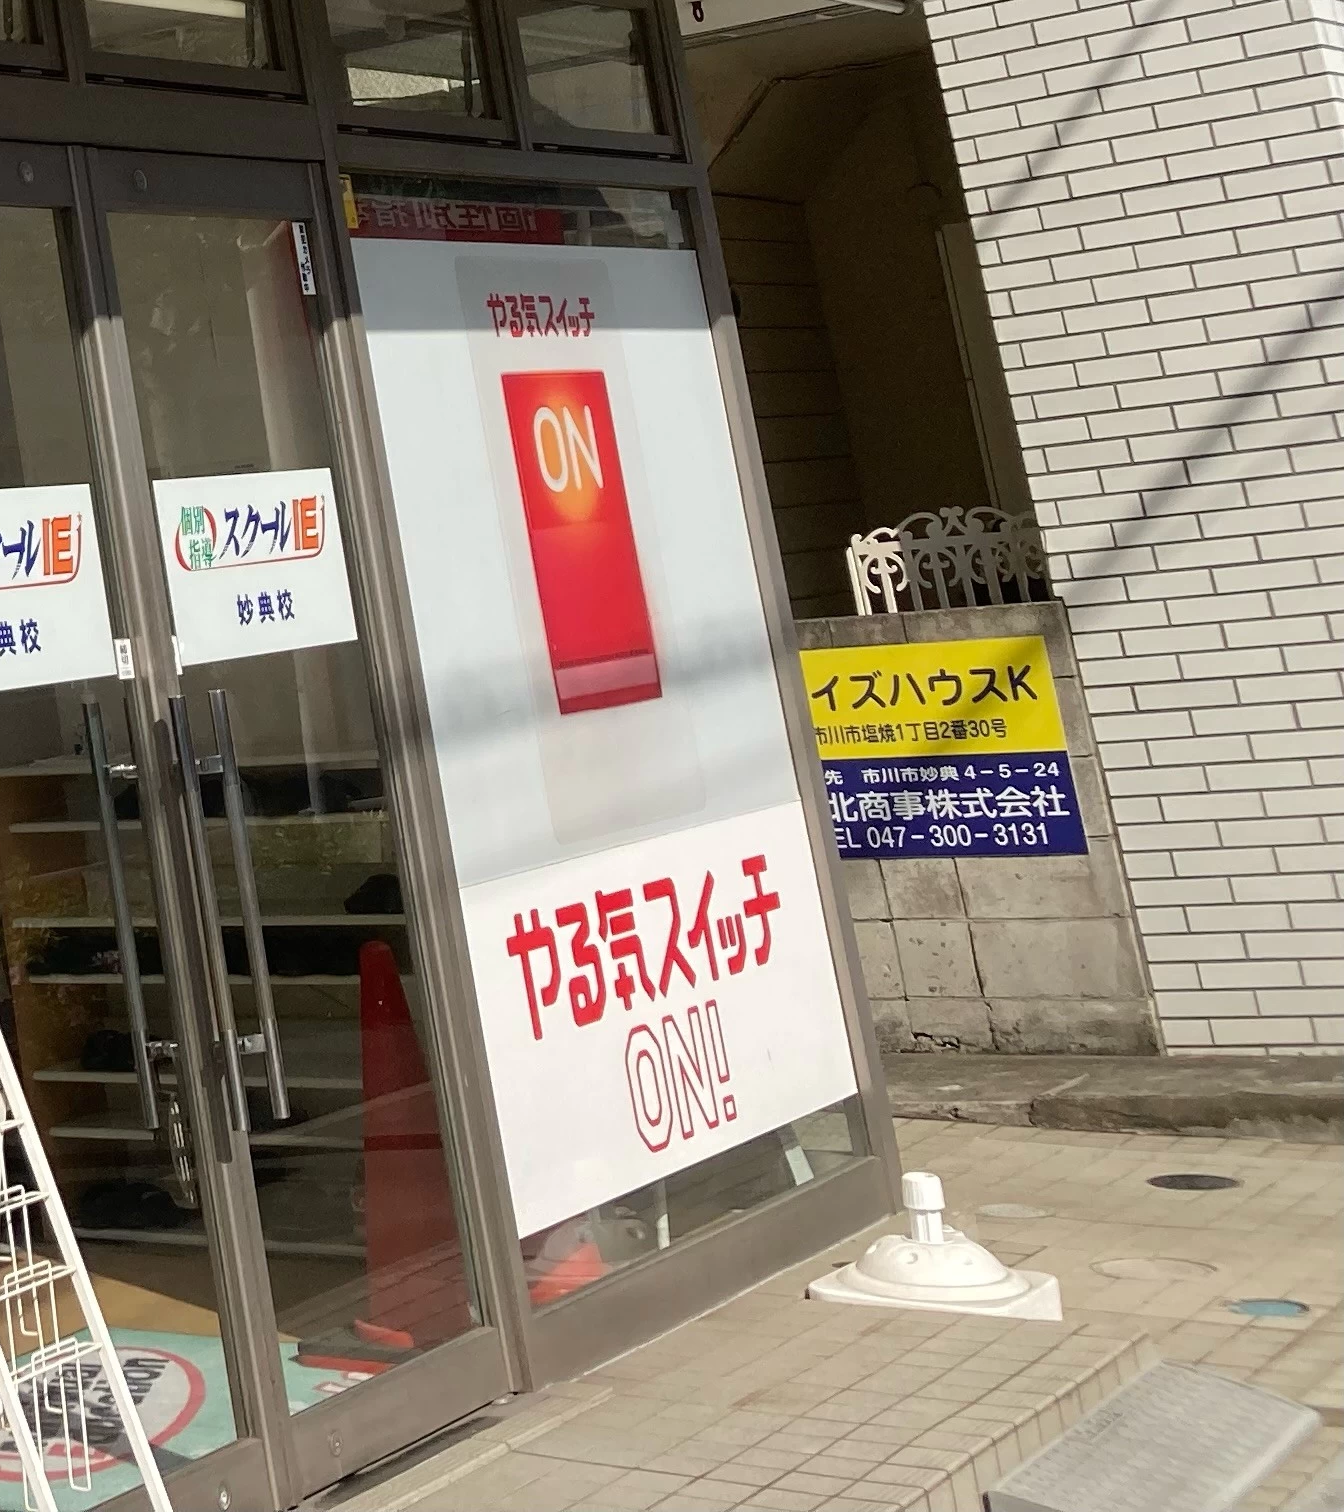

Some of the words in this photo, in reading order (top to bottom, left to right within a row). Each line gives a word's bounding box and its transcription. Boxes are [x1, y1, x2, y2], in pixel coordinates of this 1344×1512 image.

[486, 292, 596, 338] やる気スイッチ
[531, 402, 605, 493] ON
[180, 504, 206, 536] 個別
[188, 538, 216, 571] 指導
[236, 588, 295, 626] 妙典校
[812, 665, 1038, 711] イズハウスK
[506, 855, 780, 1040] やる気スイッチ
[625, 999, 737, 1152] ON!
